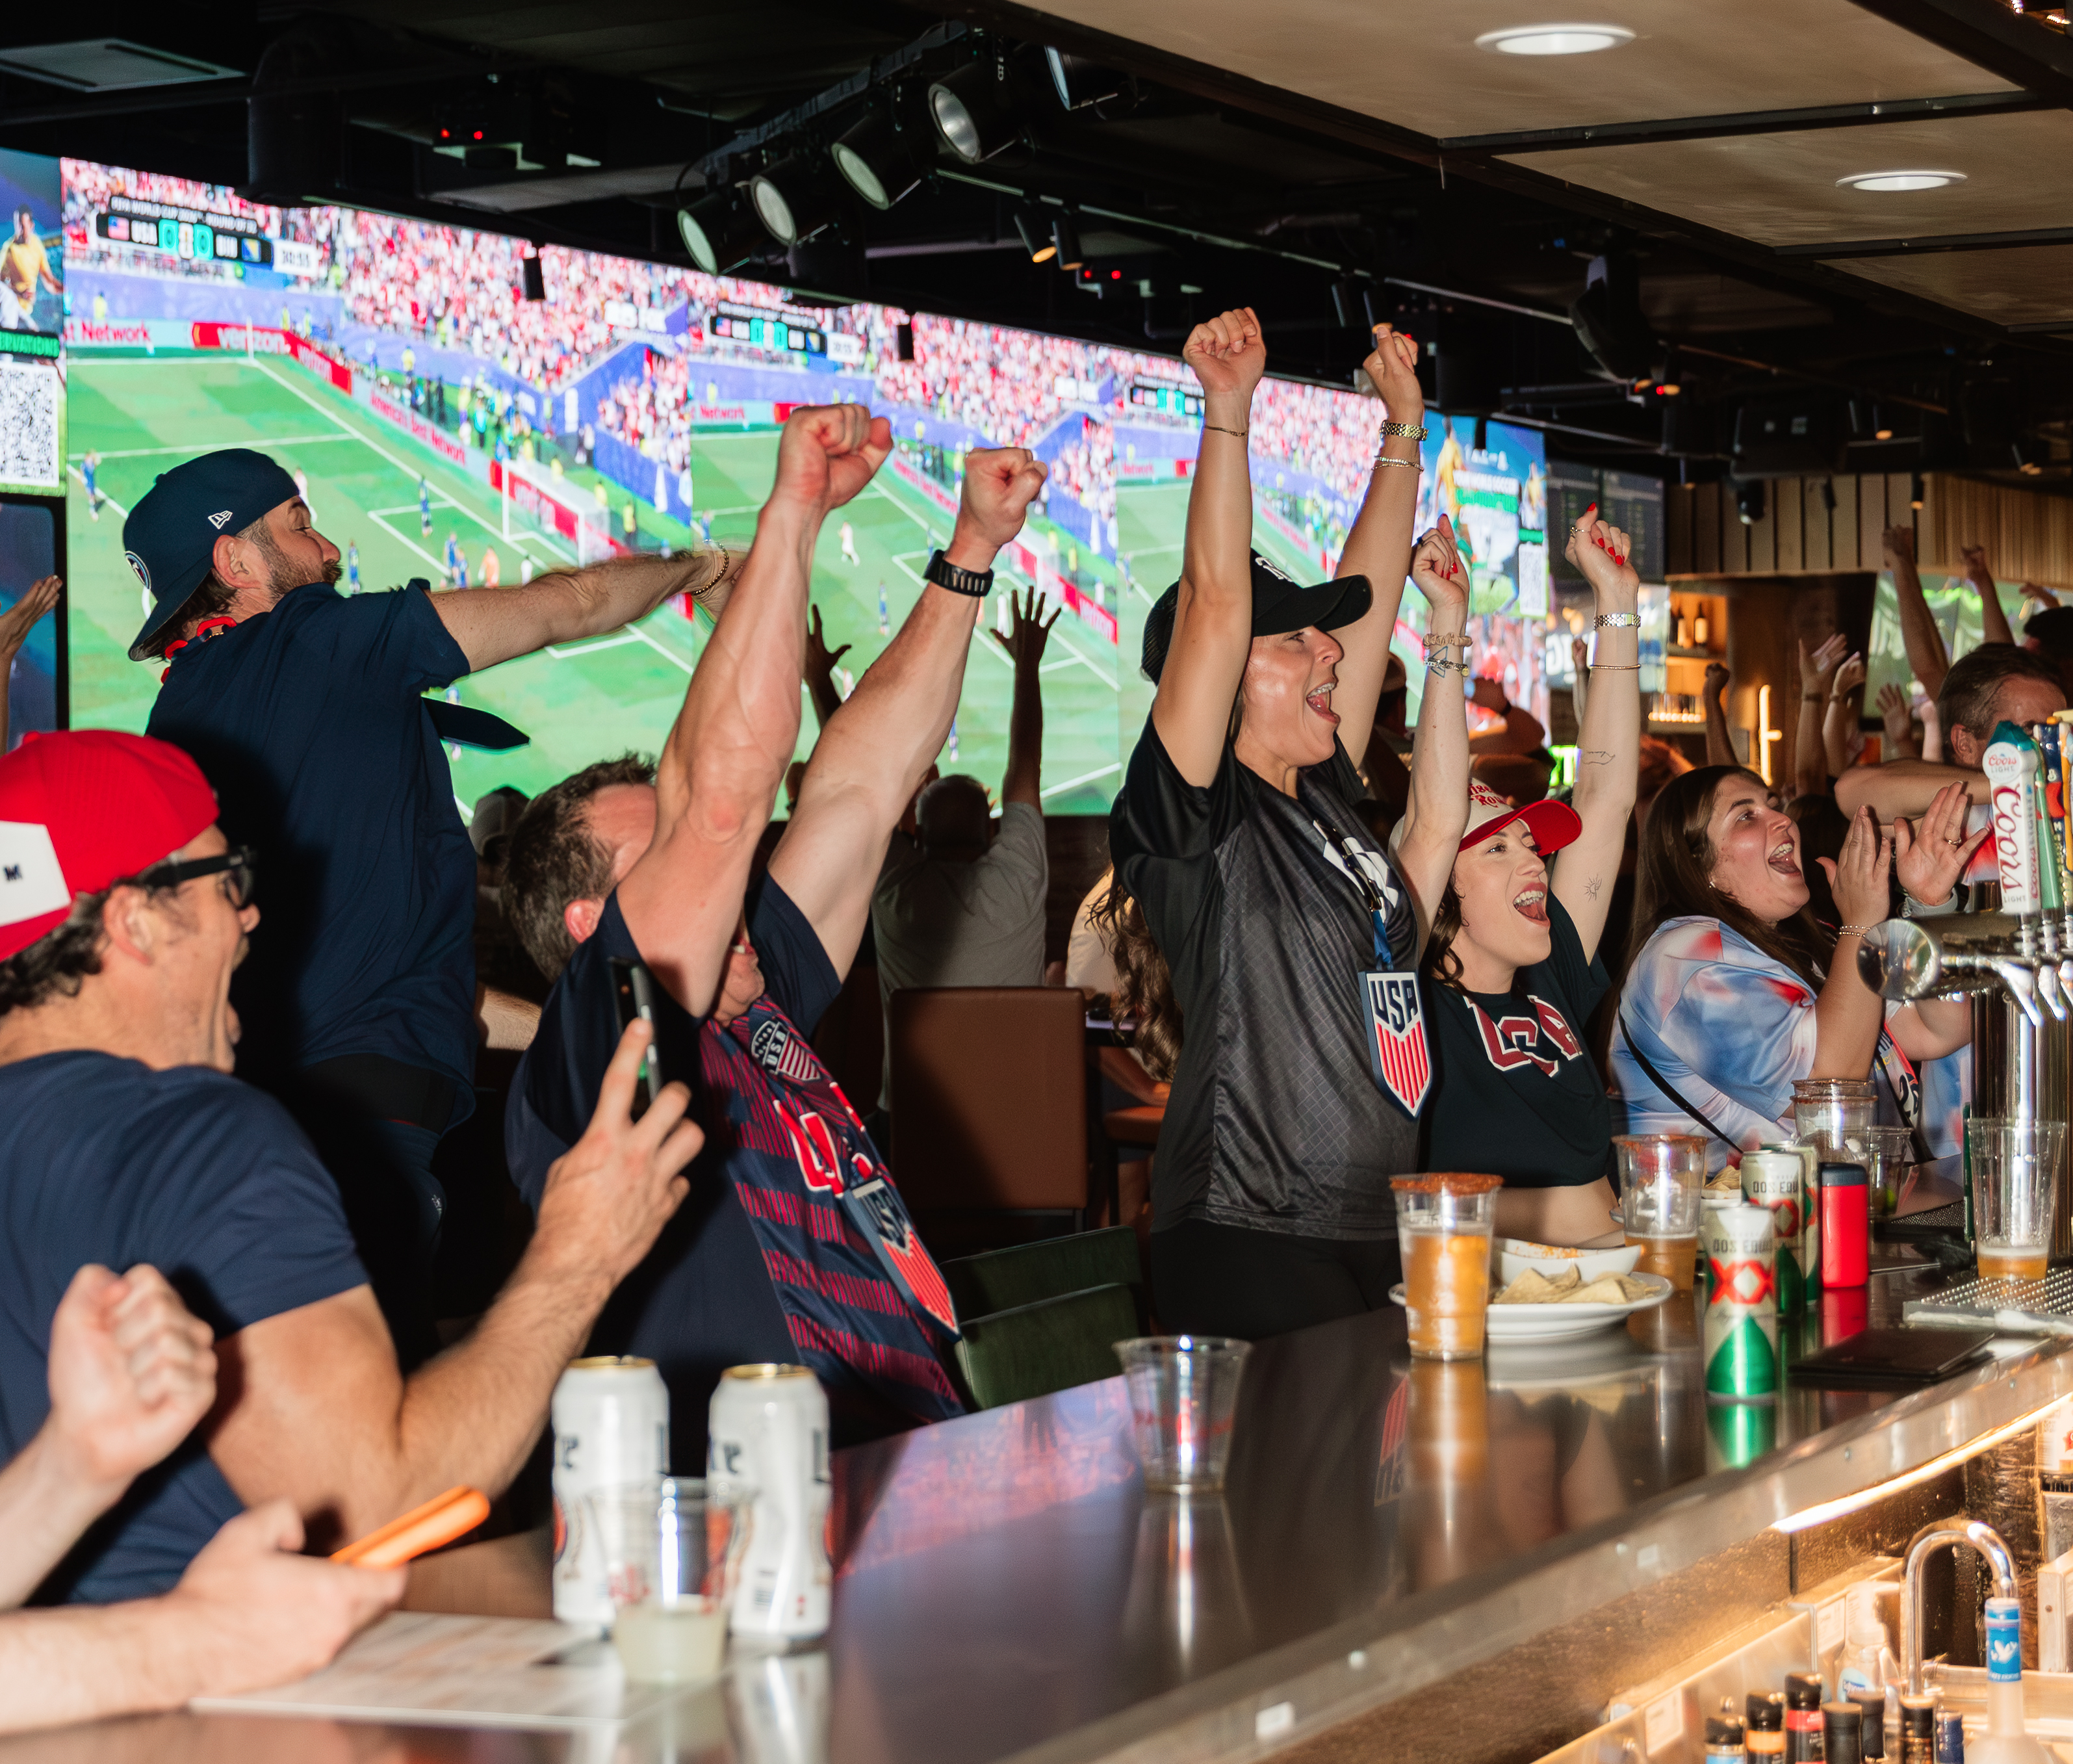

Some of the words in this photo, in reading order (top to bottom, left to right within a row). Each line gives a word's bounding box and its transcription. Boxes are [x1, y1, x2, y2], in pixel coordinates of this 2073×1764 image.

[82, 320, 151, 344] Network
[217, 328, 286, 355] verzon
[1988, 754, 2017, 766] Coors
[1993, 783, 2022, 894] Coors
[2003, 895, 2026, 903] LIGHT
[1369, 979, 1419, 1033] USA
[766, 1030, 786, 1067] USA
[1463, 994, 1583, 1078] USA
[1753, 1180, 1775, 1193] DOS
